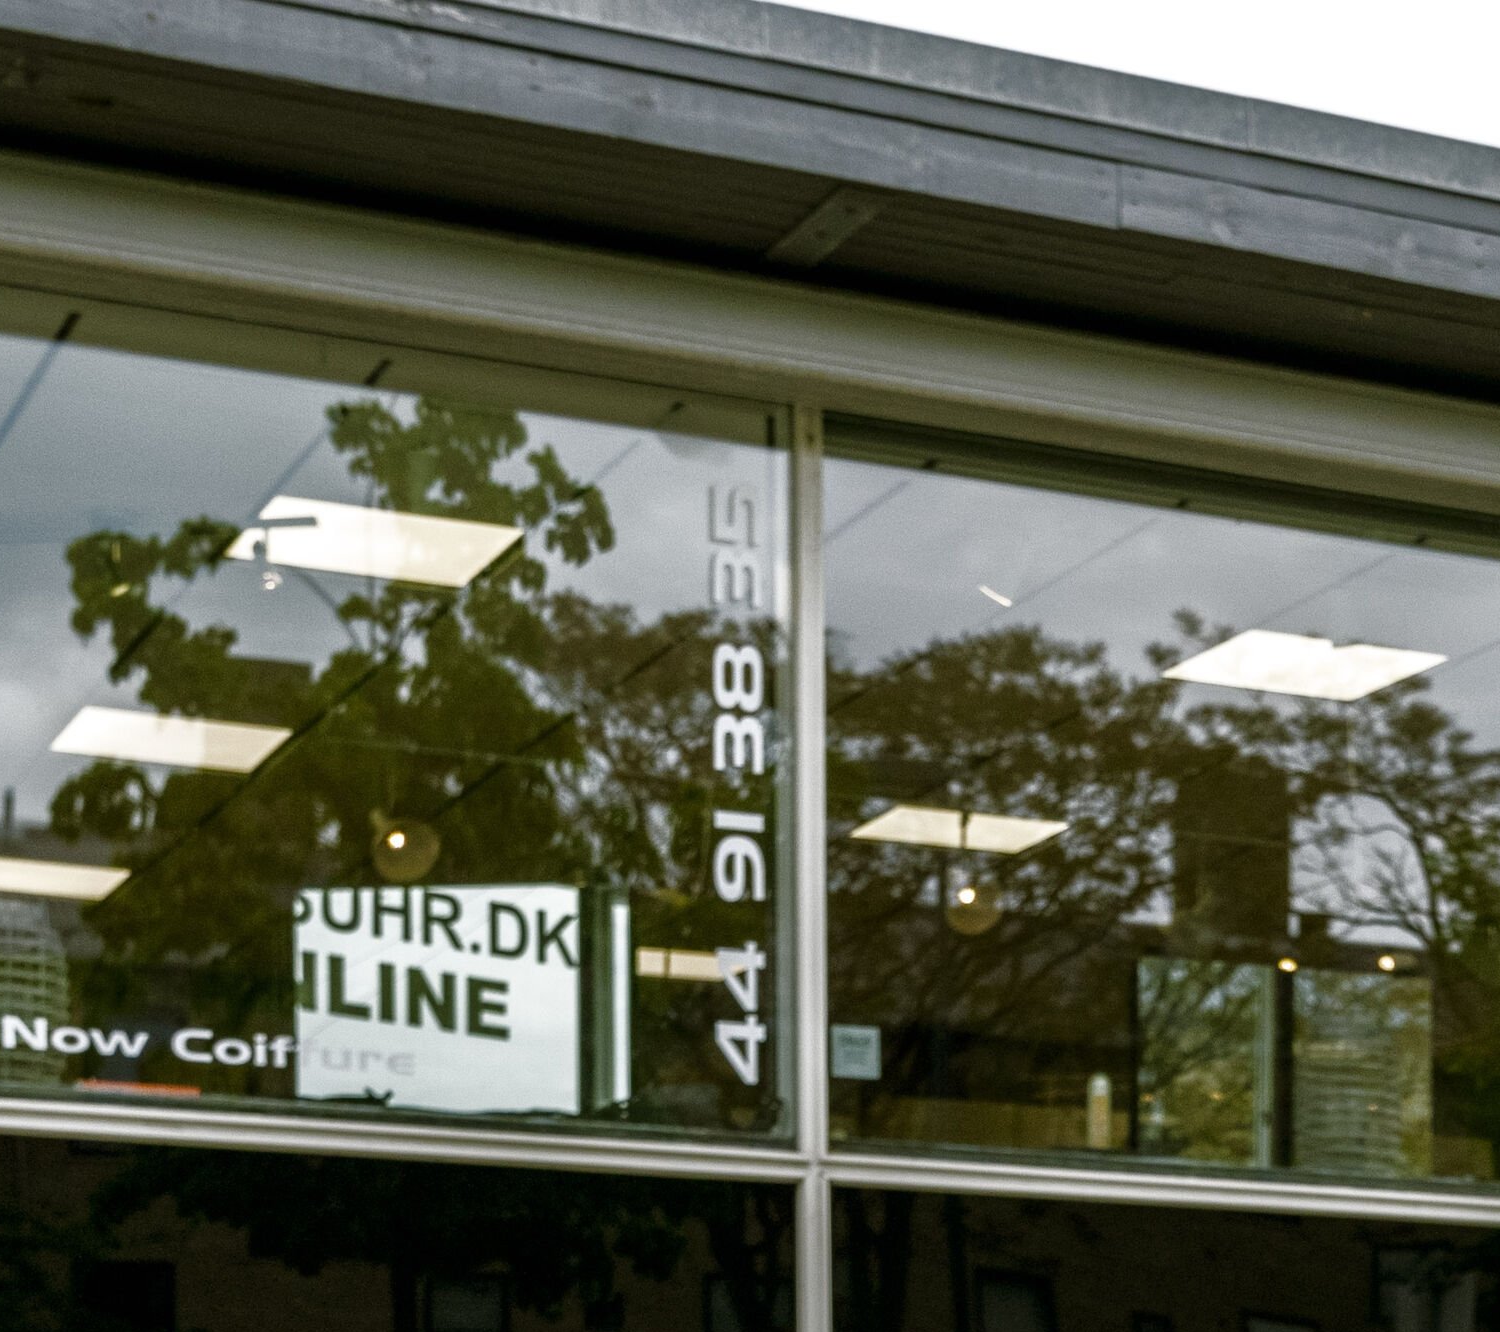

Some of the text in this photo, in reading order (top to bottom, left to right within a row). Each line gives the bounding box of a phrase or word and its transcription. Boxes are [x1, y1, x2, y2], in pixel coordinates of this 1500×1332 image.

[707, 484, 767, 1086] 44 91 38 35
[2, 1015, 149, 1058] Now
